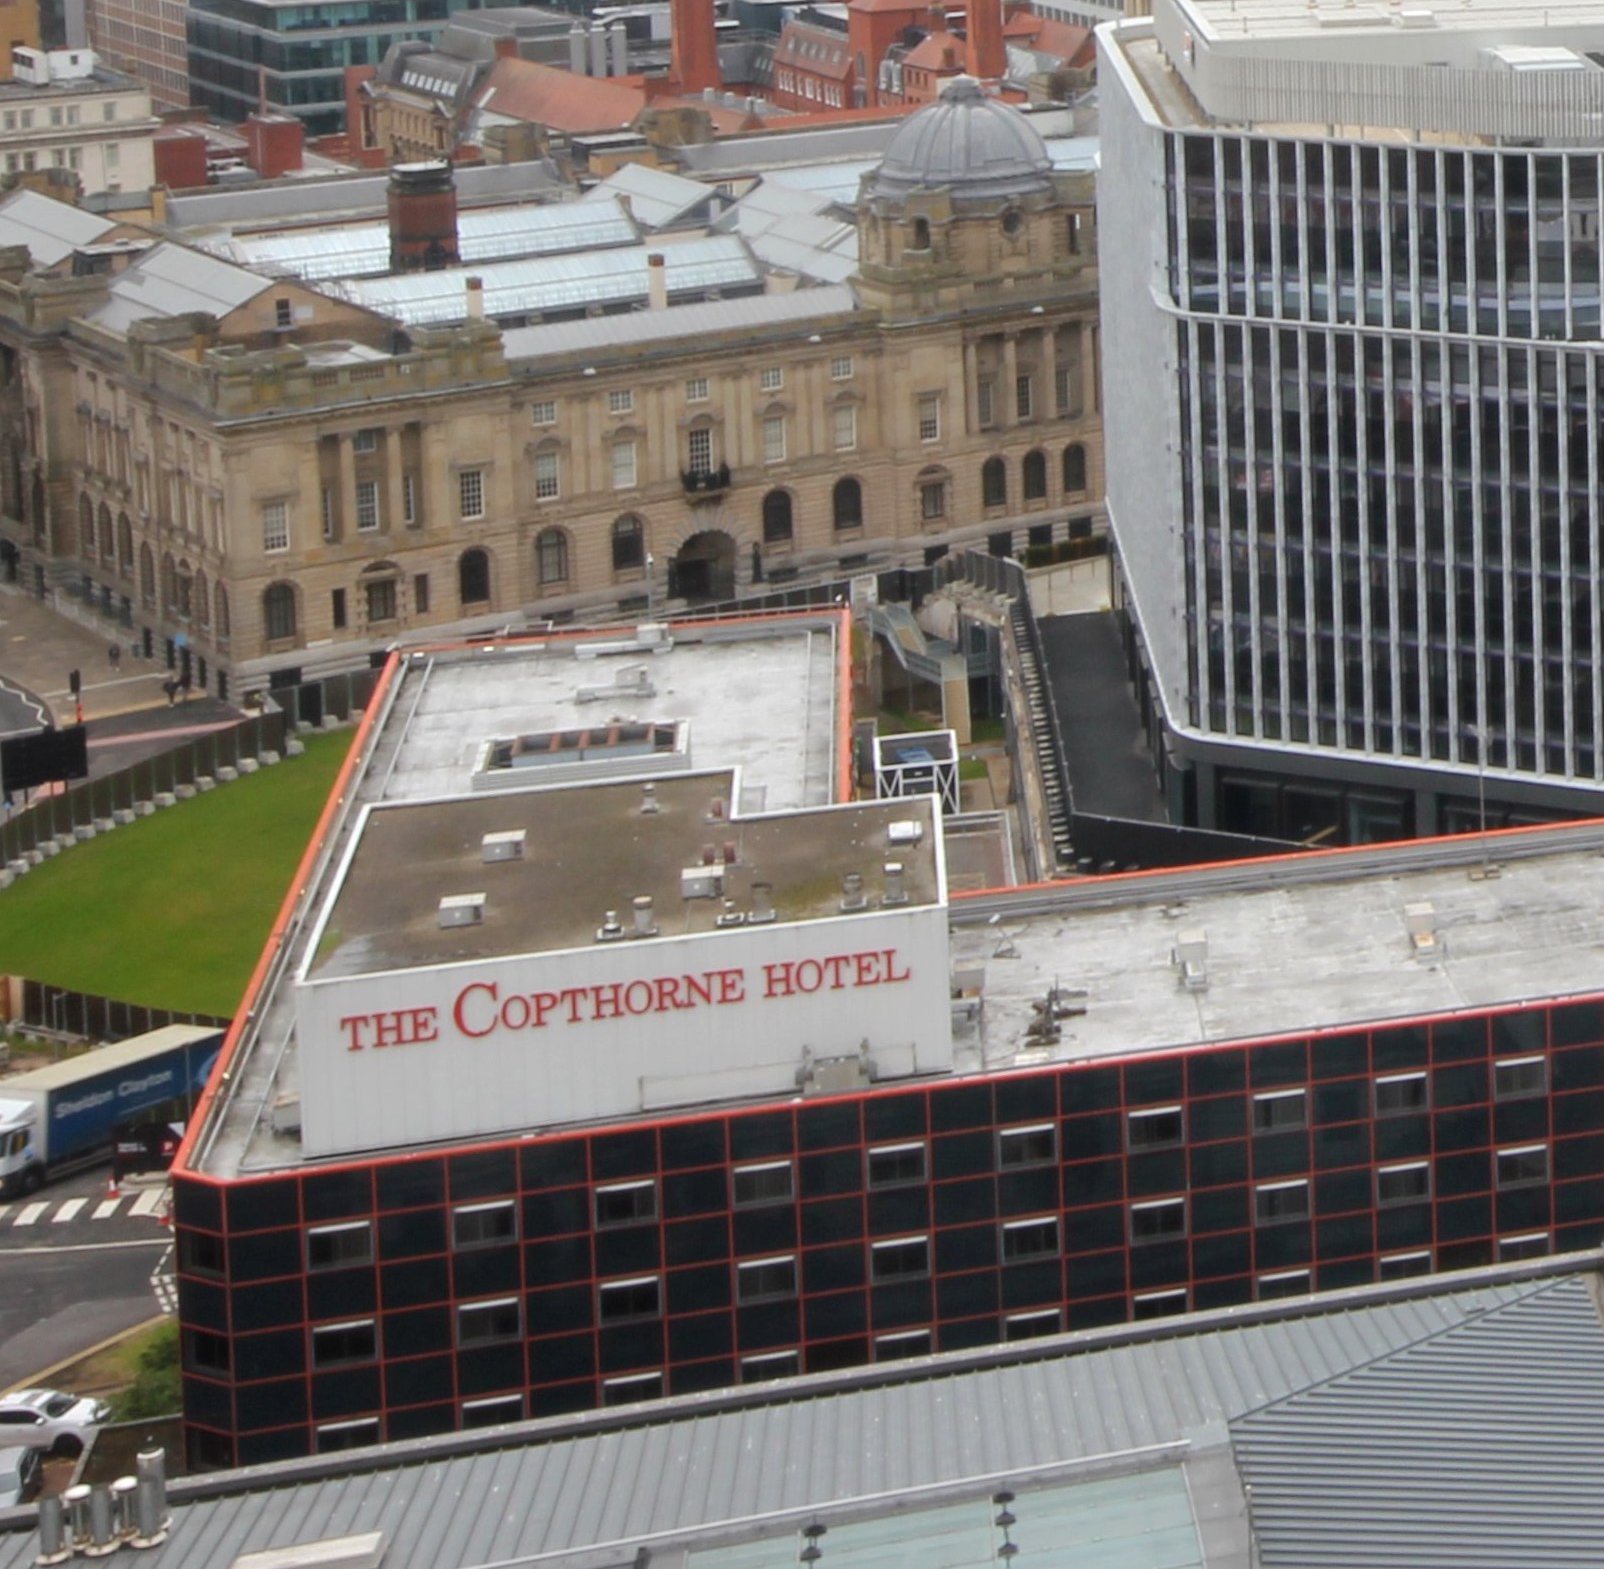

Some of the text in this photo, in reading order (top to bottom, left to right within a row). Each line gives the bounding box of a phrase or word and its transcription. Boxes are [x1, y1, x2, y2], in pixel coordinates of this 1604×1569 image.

[340, 949, 911, 1051] THE COPTHORNE HOTEL
